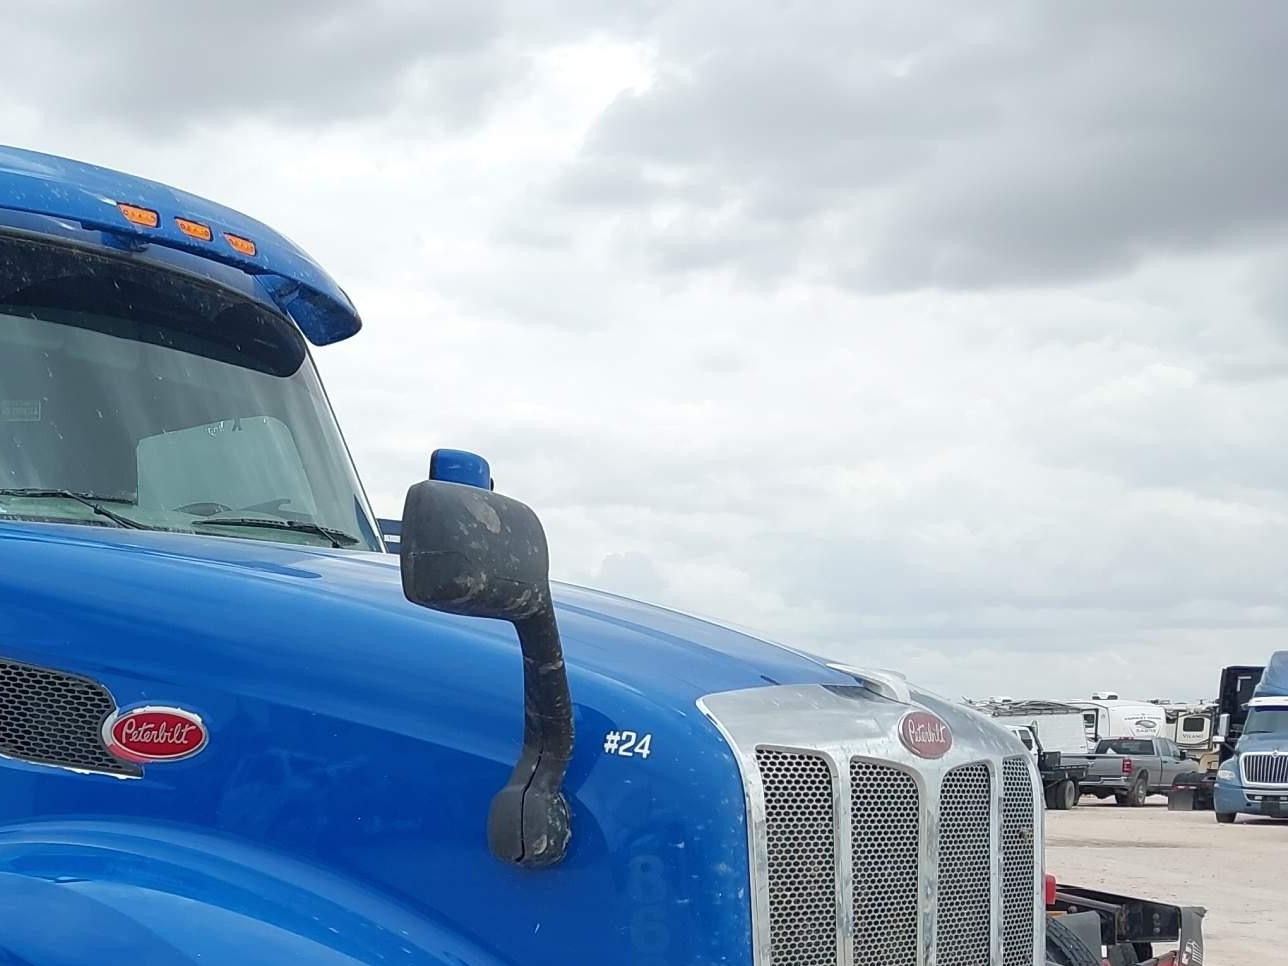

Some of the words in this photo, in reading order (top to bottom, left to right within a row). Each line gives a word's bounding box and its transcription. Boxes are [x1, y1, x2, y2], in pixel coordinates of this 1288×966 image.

[122, 718, 196, 744] Peterbilt
[908, 719, 946, 744] Peterbilt
[603, 730, 652, 759] #24
